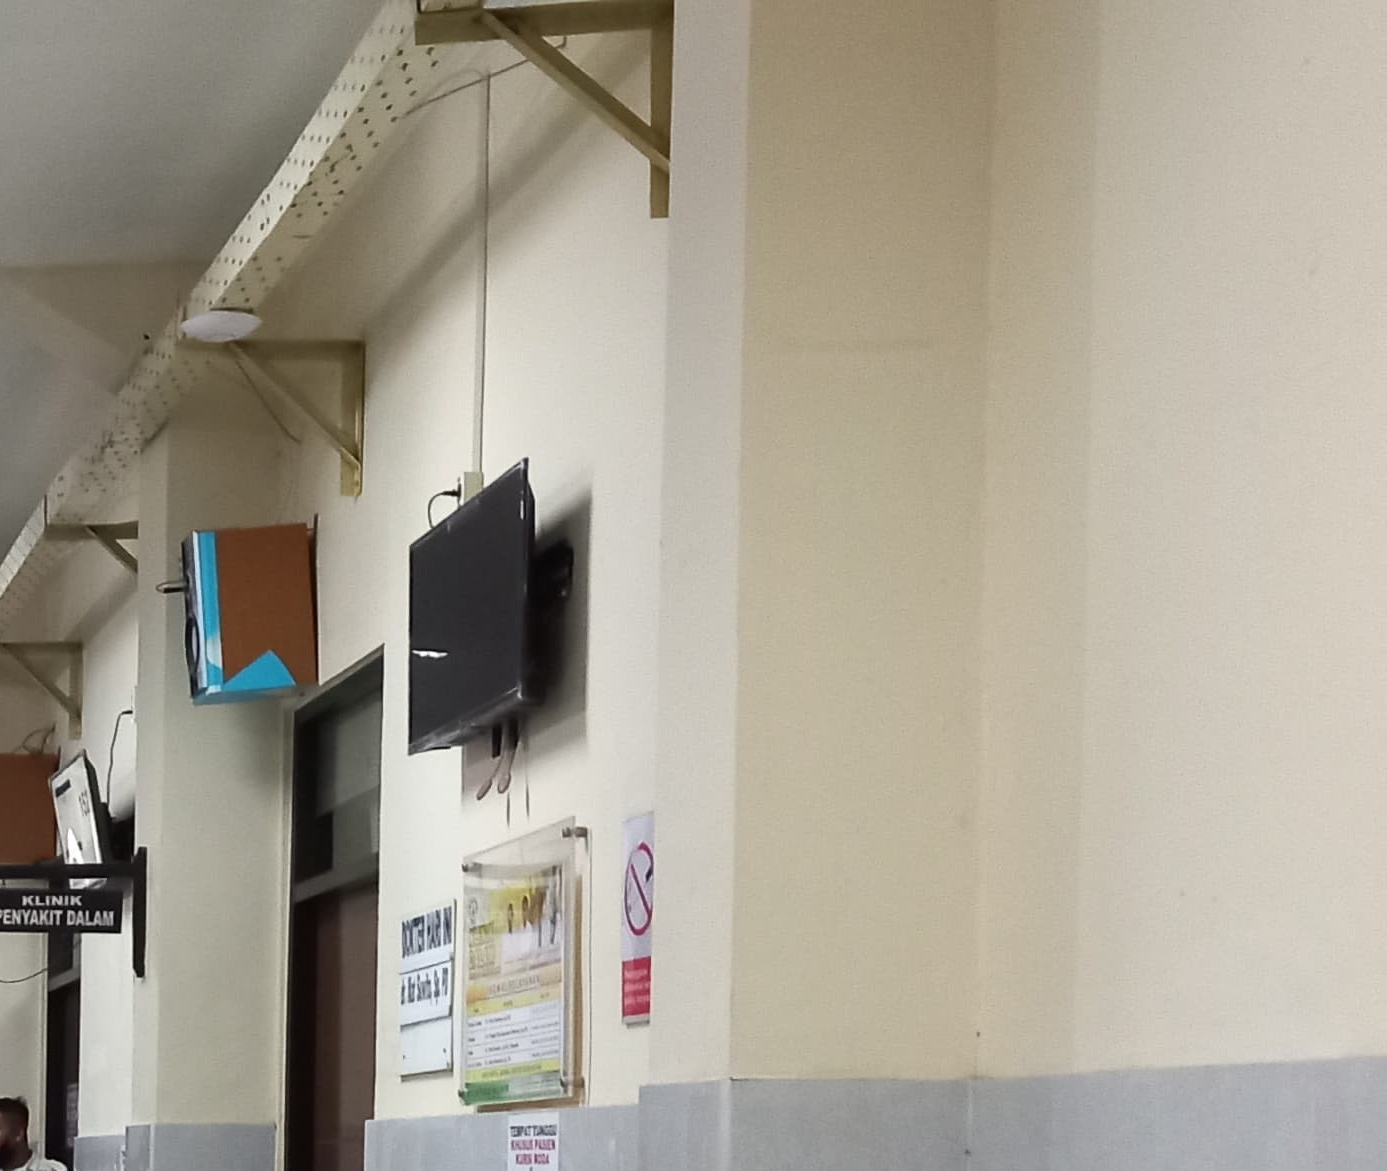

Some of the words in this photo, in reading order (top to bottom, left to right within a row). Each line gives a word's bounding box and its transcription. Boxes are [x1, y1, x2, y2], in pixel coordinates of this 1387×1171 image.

[22, 895, 82, 906] KLINIK
[67, 910, 114, 926] DALAM
[402, 915, 424, 958] DOKTER
[426, 909, 441, 950] HARI
